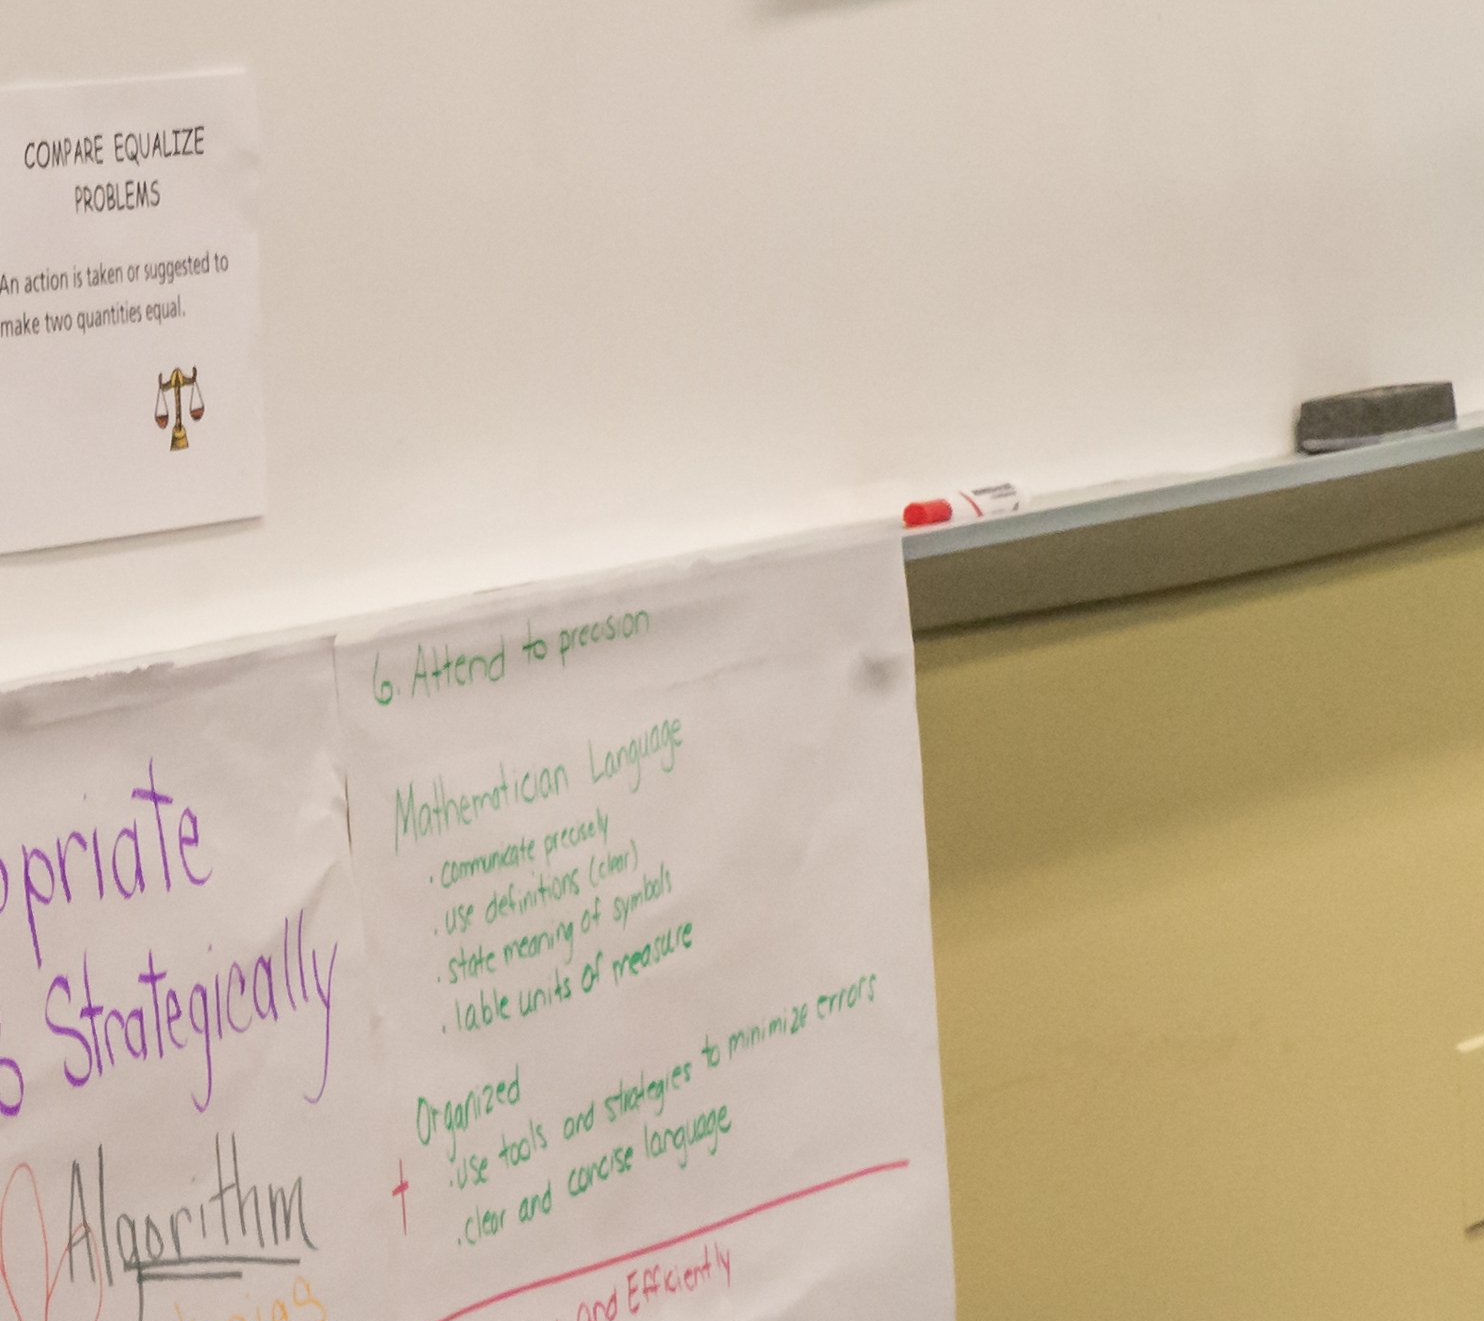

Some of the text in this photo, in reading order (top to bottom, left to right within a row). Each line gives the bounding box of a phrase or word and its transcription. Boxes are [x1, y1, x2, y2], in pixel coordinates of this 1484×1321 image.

[24, 126, 205, 169] COMPARE EQUALIZE
[74, 180, 161, 214] PROBLEMS
[0, 250, 229, 295] An action is taken or suggested to
[0, 294, 186, 338] make two quantities equal.
[411, 633, 505, 699] Attend
[522, 617, 548, 665] to
[588, 718, 683, 793] Language
[0, 757, 212, 969] priate
[519, 968, 572, 1017] units
[581, 950, 603, 993] of
[612, 921, 693, 986] measure
[45, 908, 338, 1112] Strategically
[416, 1063, 521, 1163] Organized
